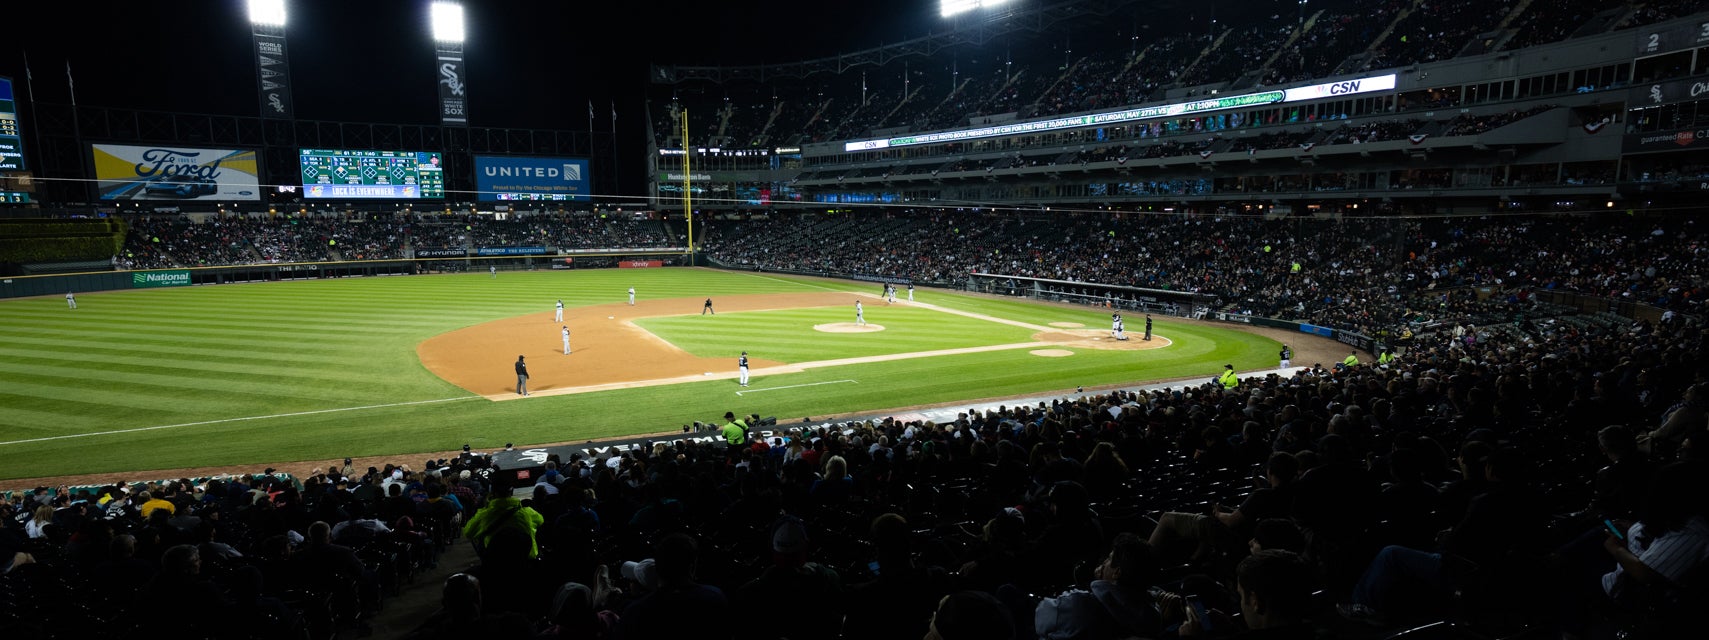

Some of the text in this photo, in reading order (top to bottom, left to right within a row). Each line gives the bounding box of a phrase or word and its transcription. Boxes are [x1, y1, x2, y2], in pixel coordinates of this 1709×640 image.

[1647, 33, 1659, 47] 2
[1330, 80, 1361, 94] CSN
[1197, 100, 1220, 109] 1:10PM
[1094, 112, 1126, 122] SATURDAY,
[1126, 111, 1140, 119] MAY
[1141, 109, 1157, 117] 27TH
[967, 128, 993, 136] PRESENTED
[1048, 120, 1067, 128] 20,000
[1067, 118, 1082, 126] FANS
[1641, 134, 1677, 145] guaranteed
[135, 149, 221, 180] Ford
[485, 166, 559, 178] UNITED
[146, 272, 189, 282] National
